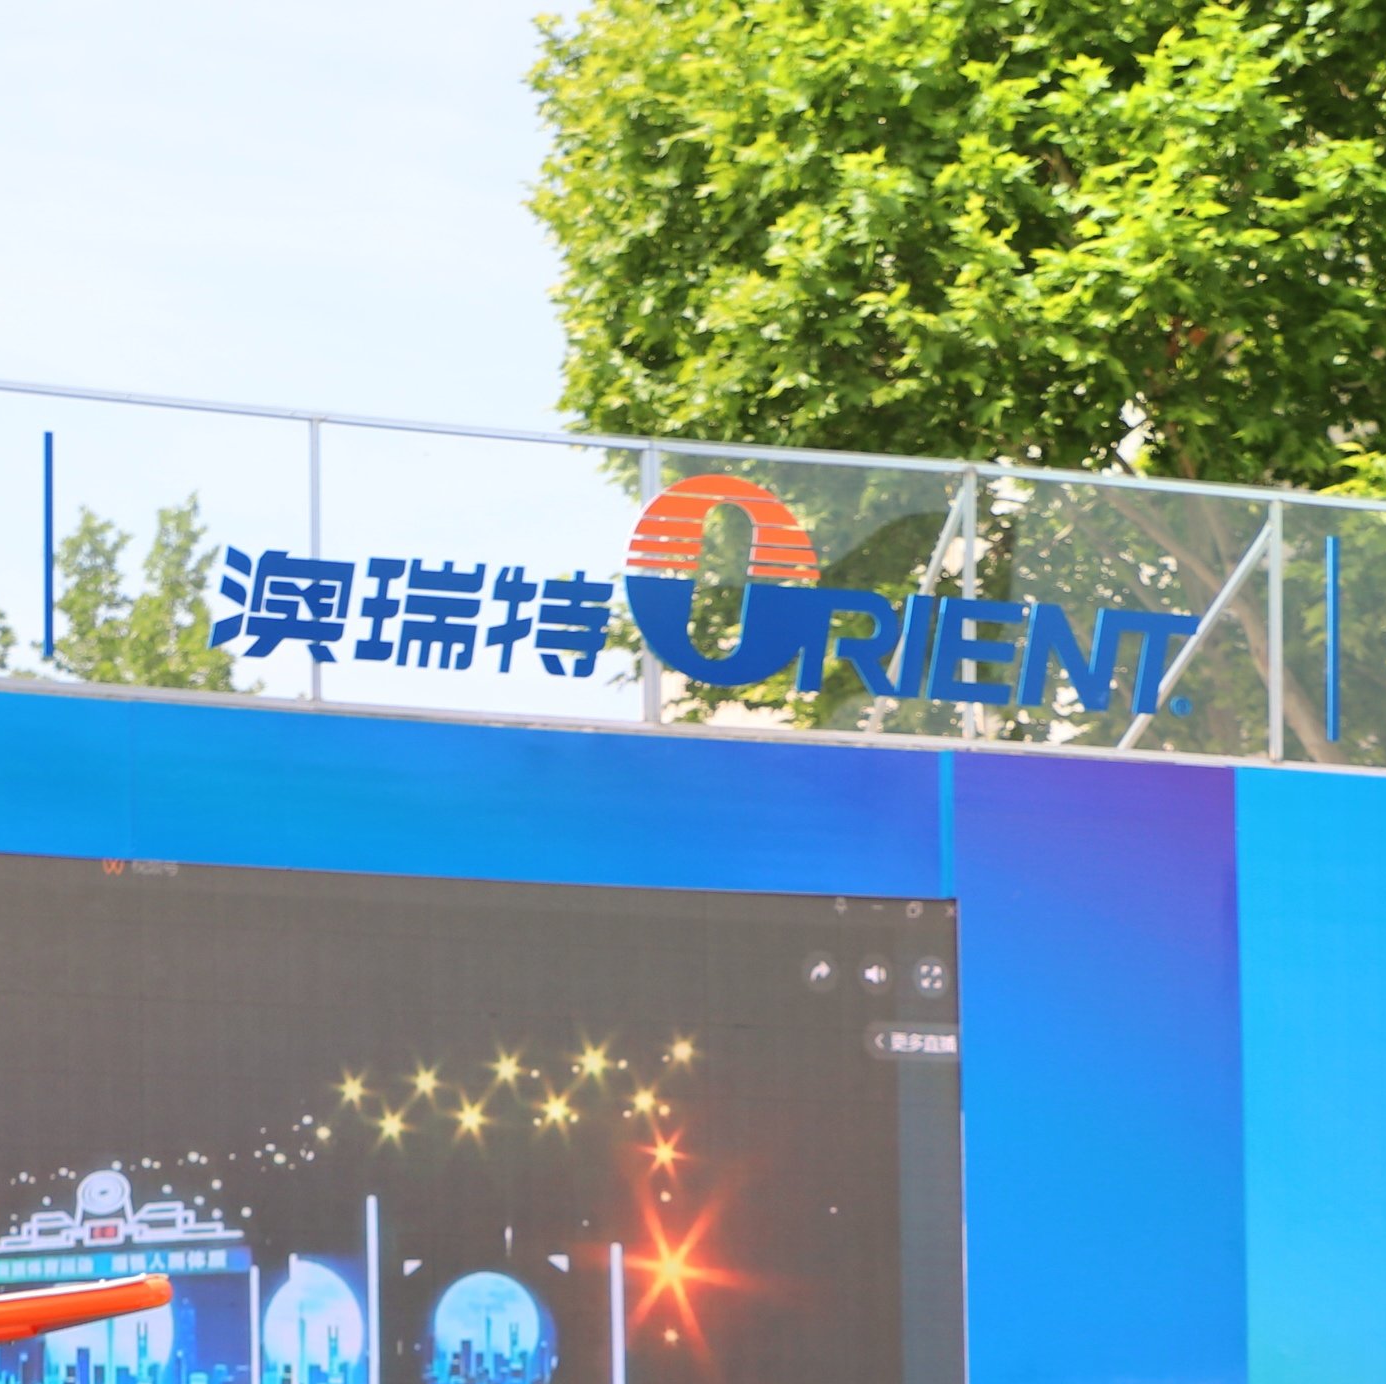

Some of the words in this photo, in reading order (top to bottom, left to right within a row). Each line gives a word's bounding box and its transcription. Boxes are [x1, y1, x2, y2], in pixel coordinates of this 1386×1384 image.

[211, 544, 615, 680] 澳瑞特
[625, 474, 1203, 716] ORIENT
